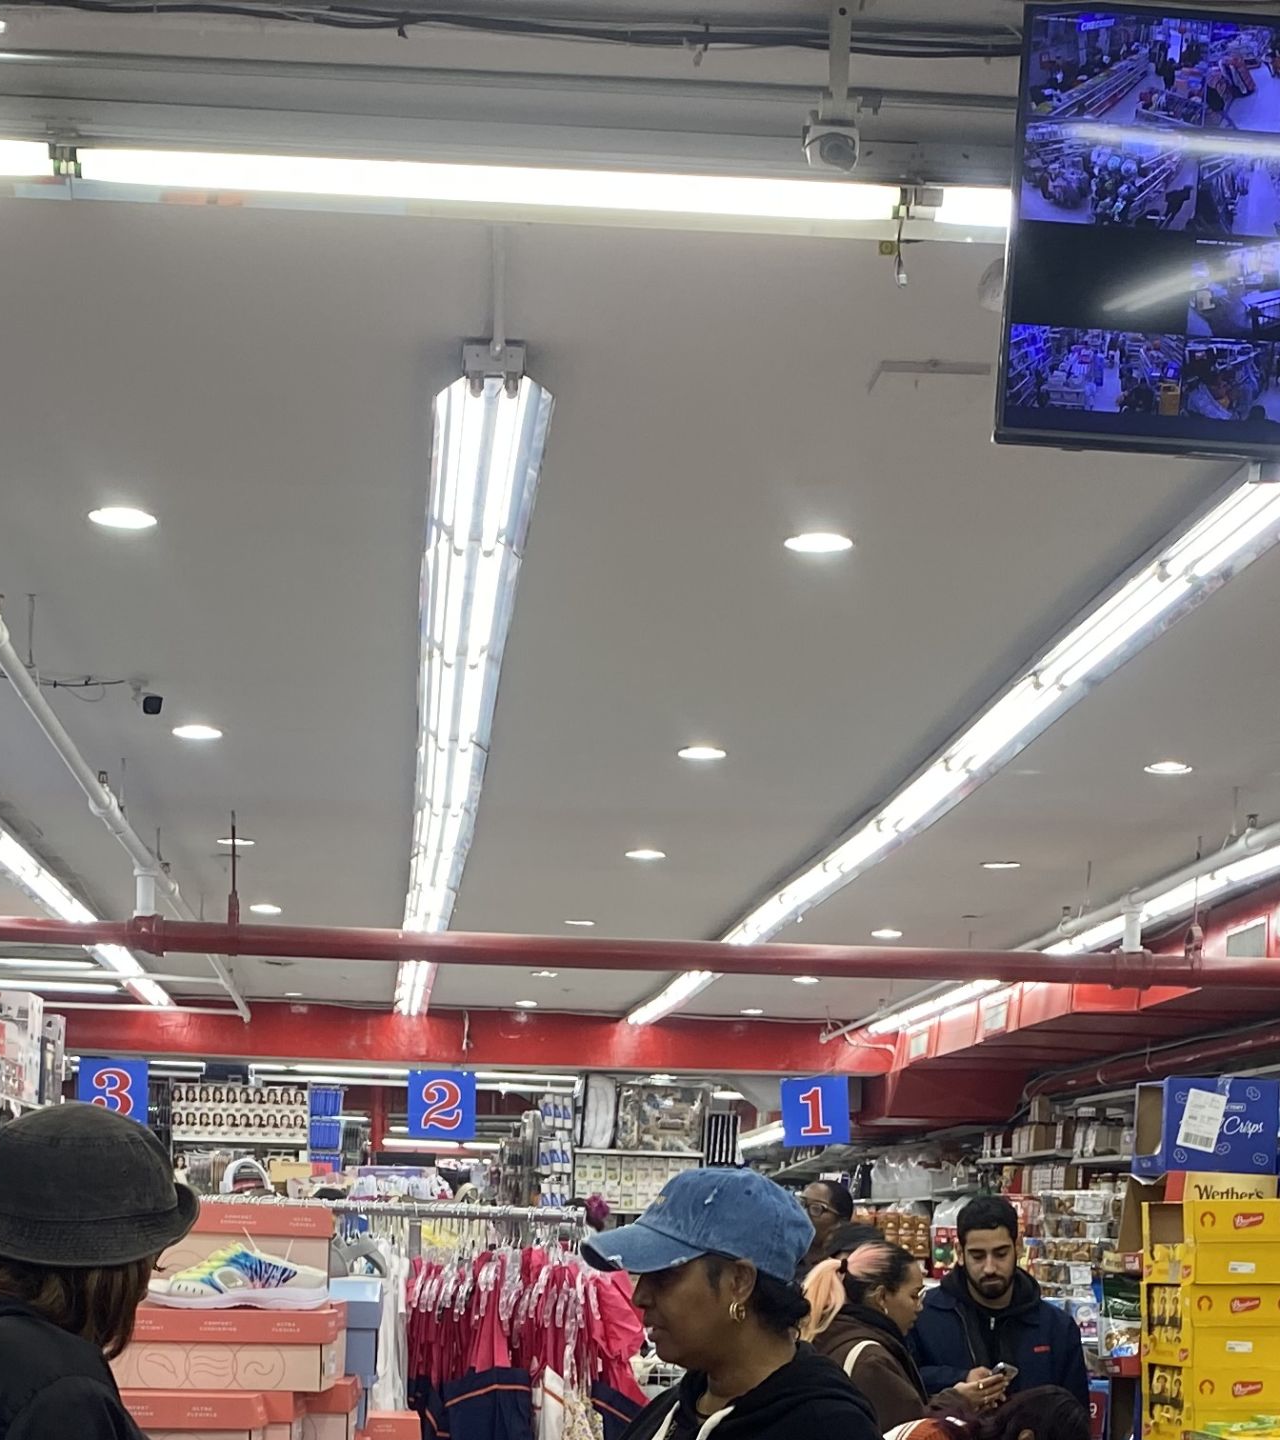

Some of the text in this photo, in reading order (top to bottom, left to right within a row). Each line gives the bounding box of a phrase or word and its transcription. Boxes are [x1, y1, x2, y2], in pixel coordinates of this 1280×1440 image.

[92, 1068, 133, 1116] 3
[422, 1079, 462, 1130] 2
[800, 1087, 832, 1136] 1
[1223, 1116, 1264, 1138] Crisps
